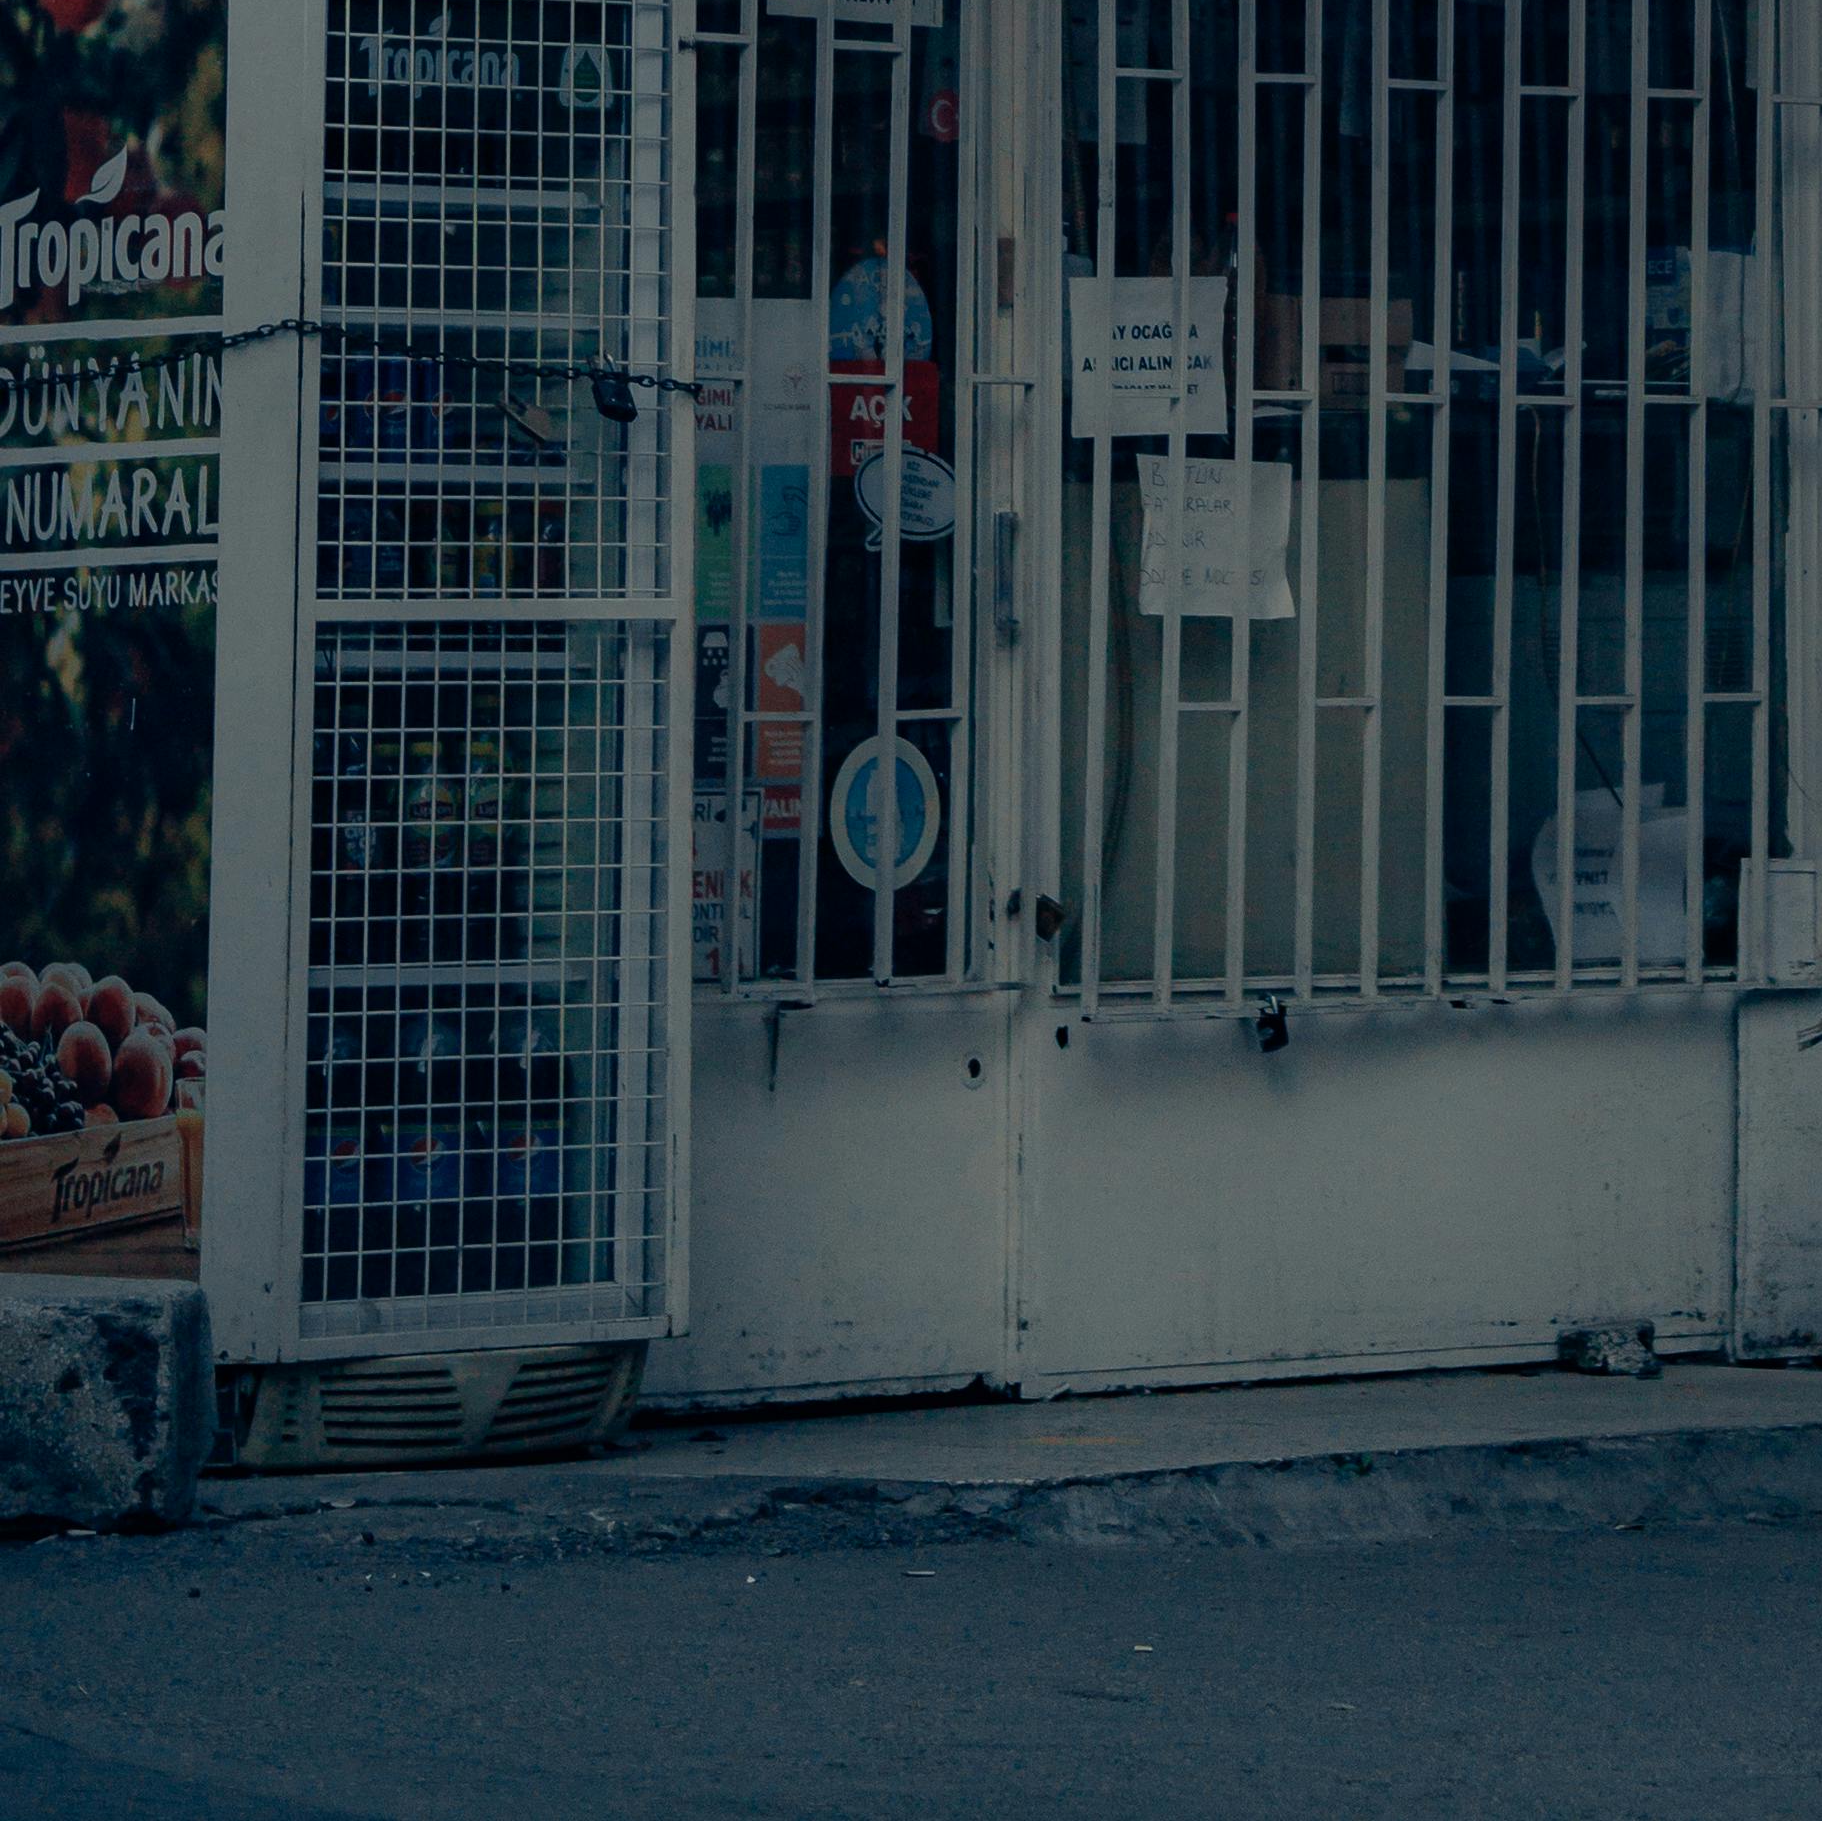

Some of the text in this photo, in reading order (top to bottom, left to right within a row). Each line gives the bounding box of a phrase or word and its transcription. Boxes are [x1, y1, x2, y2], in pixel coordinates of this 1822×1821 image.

[360, 26, 520, 100] Tropicana
[849, 394, 913, 429] AÇK
[63, 573, 122, 613] SUYU
[51, 1157, 165, 1224] Tropicana
